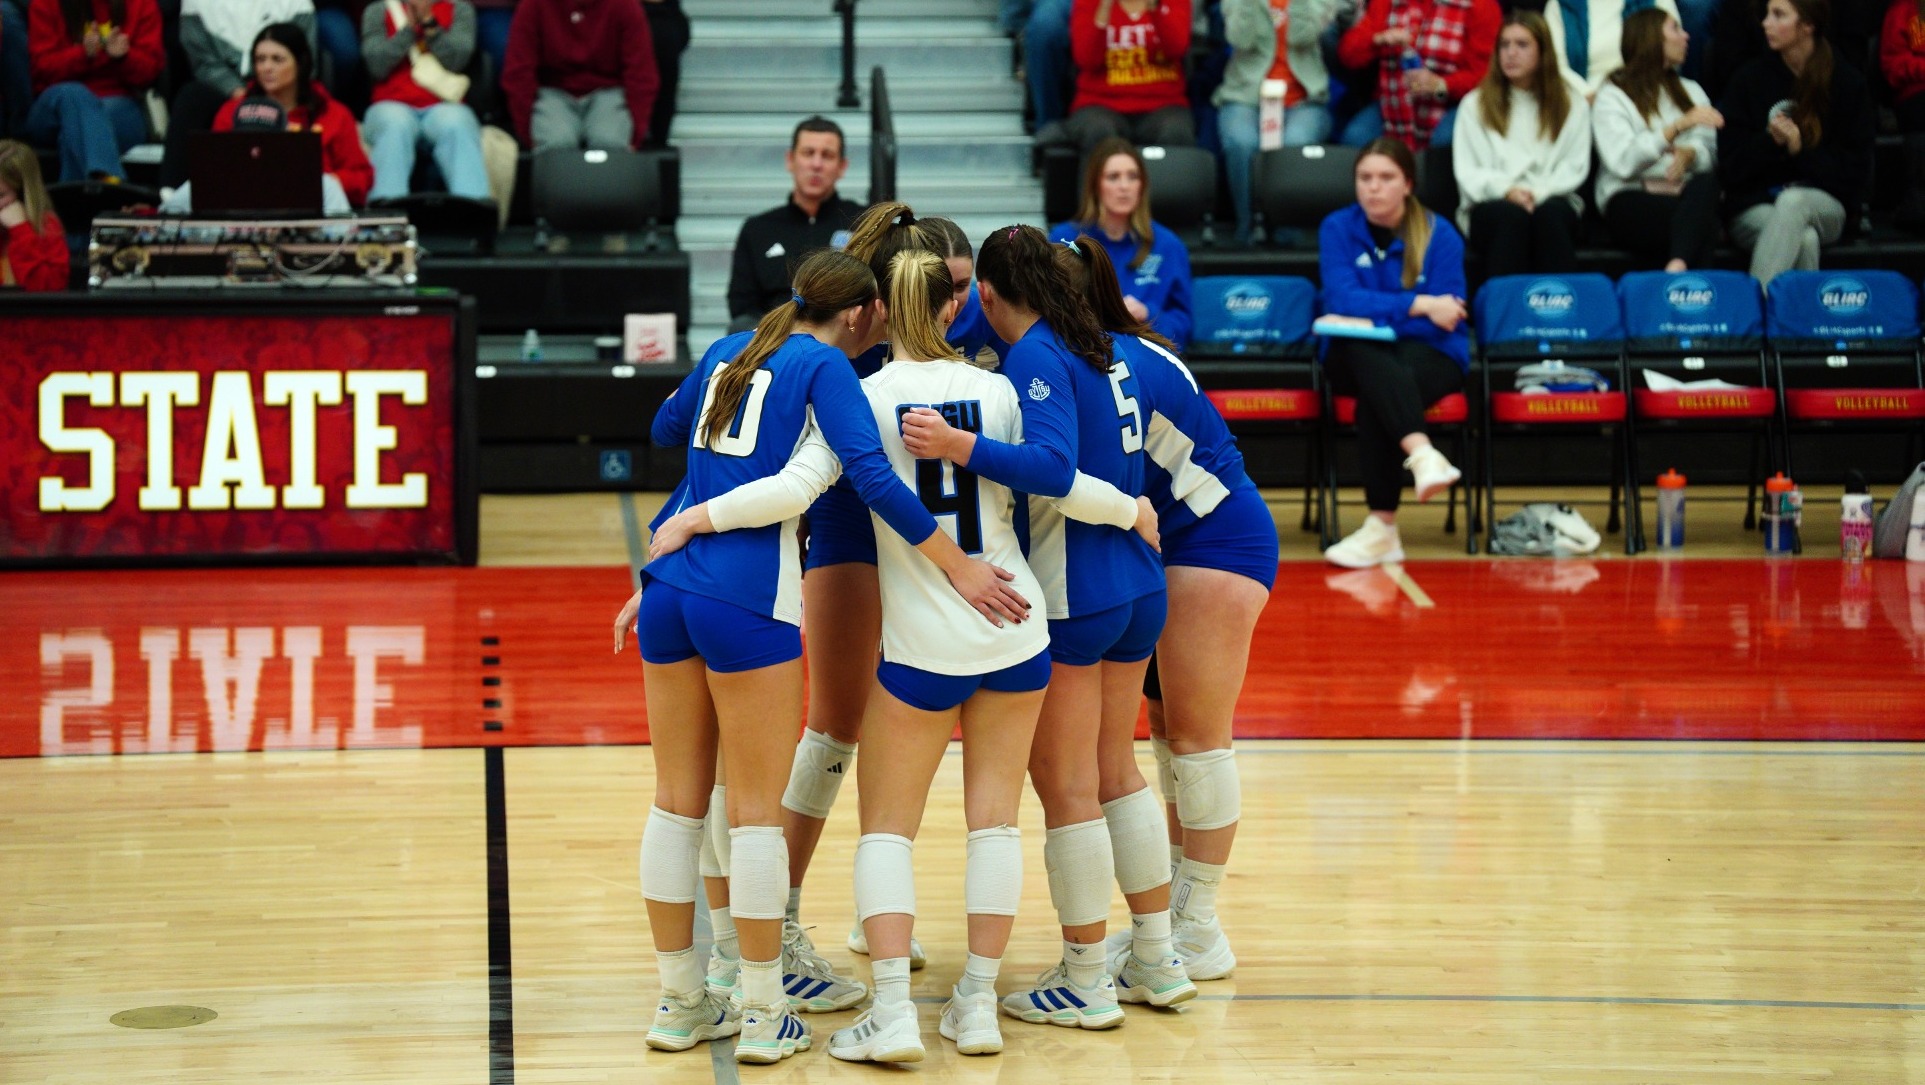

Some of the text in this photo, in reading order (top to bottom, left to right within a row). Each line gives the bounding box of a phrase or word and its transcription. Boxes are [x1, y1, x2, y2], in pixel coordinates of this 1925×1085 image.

[692, 360, 774, 458] 10
[1106, 360, 1143, 454] 5
[1226, 397, 1296, 411] VOLLEYBALL
[1527, 399, 1599, 414] VOLLEYBALL
[1677, 395, 1749, 410] VOLLEYBALL
[1835, 396, 1909, 411] VOLLEYBALL
[38, 370, 428, 512] STATE
[915, 458, 983, 555] 4
